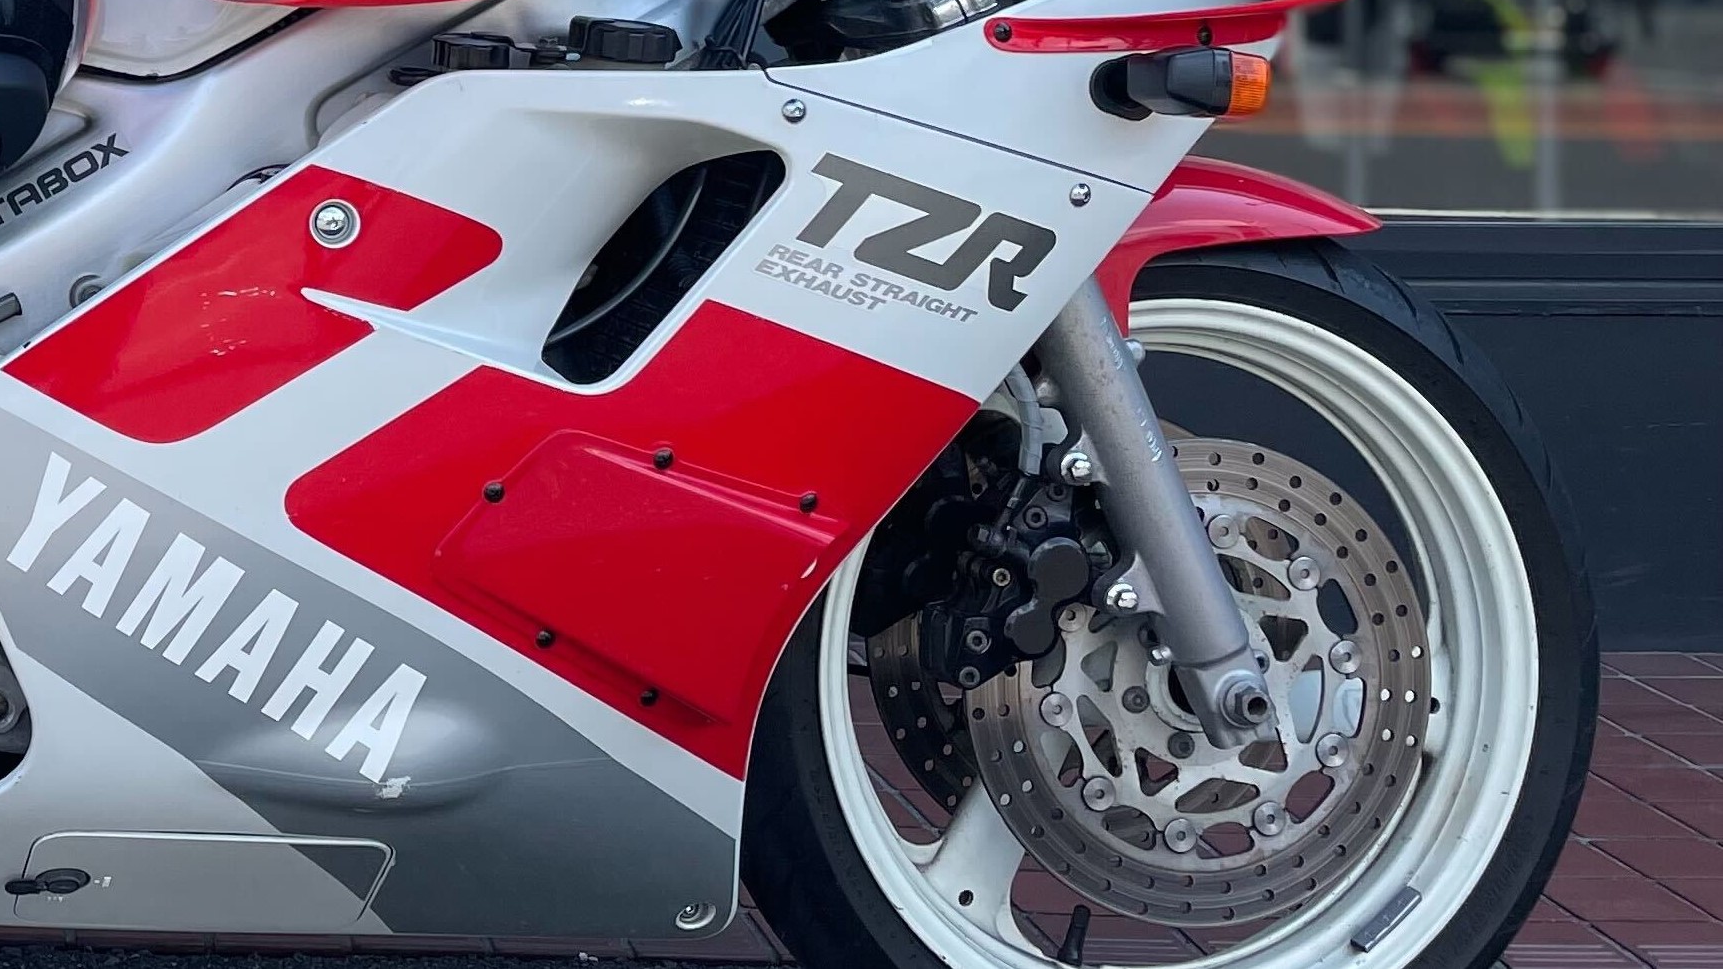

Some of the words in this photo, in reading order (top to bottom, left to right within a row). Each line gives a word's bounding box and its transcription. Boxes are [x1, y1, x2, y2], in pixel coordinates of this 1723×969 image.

[753, 259, 887, 311] EXHAUST
[767, 243, 844, 279] REAR
[849, 272, 979, 323] STRAIGHT
[795, 152, 1057, 312] TZR
[5, 451, 428, 784] YAMAHA
